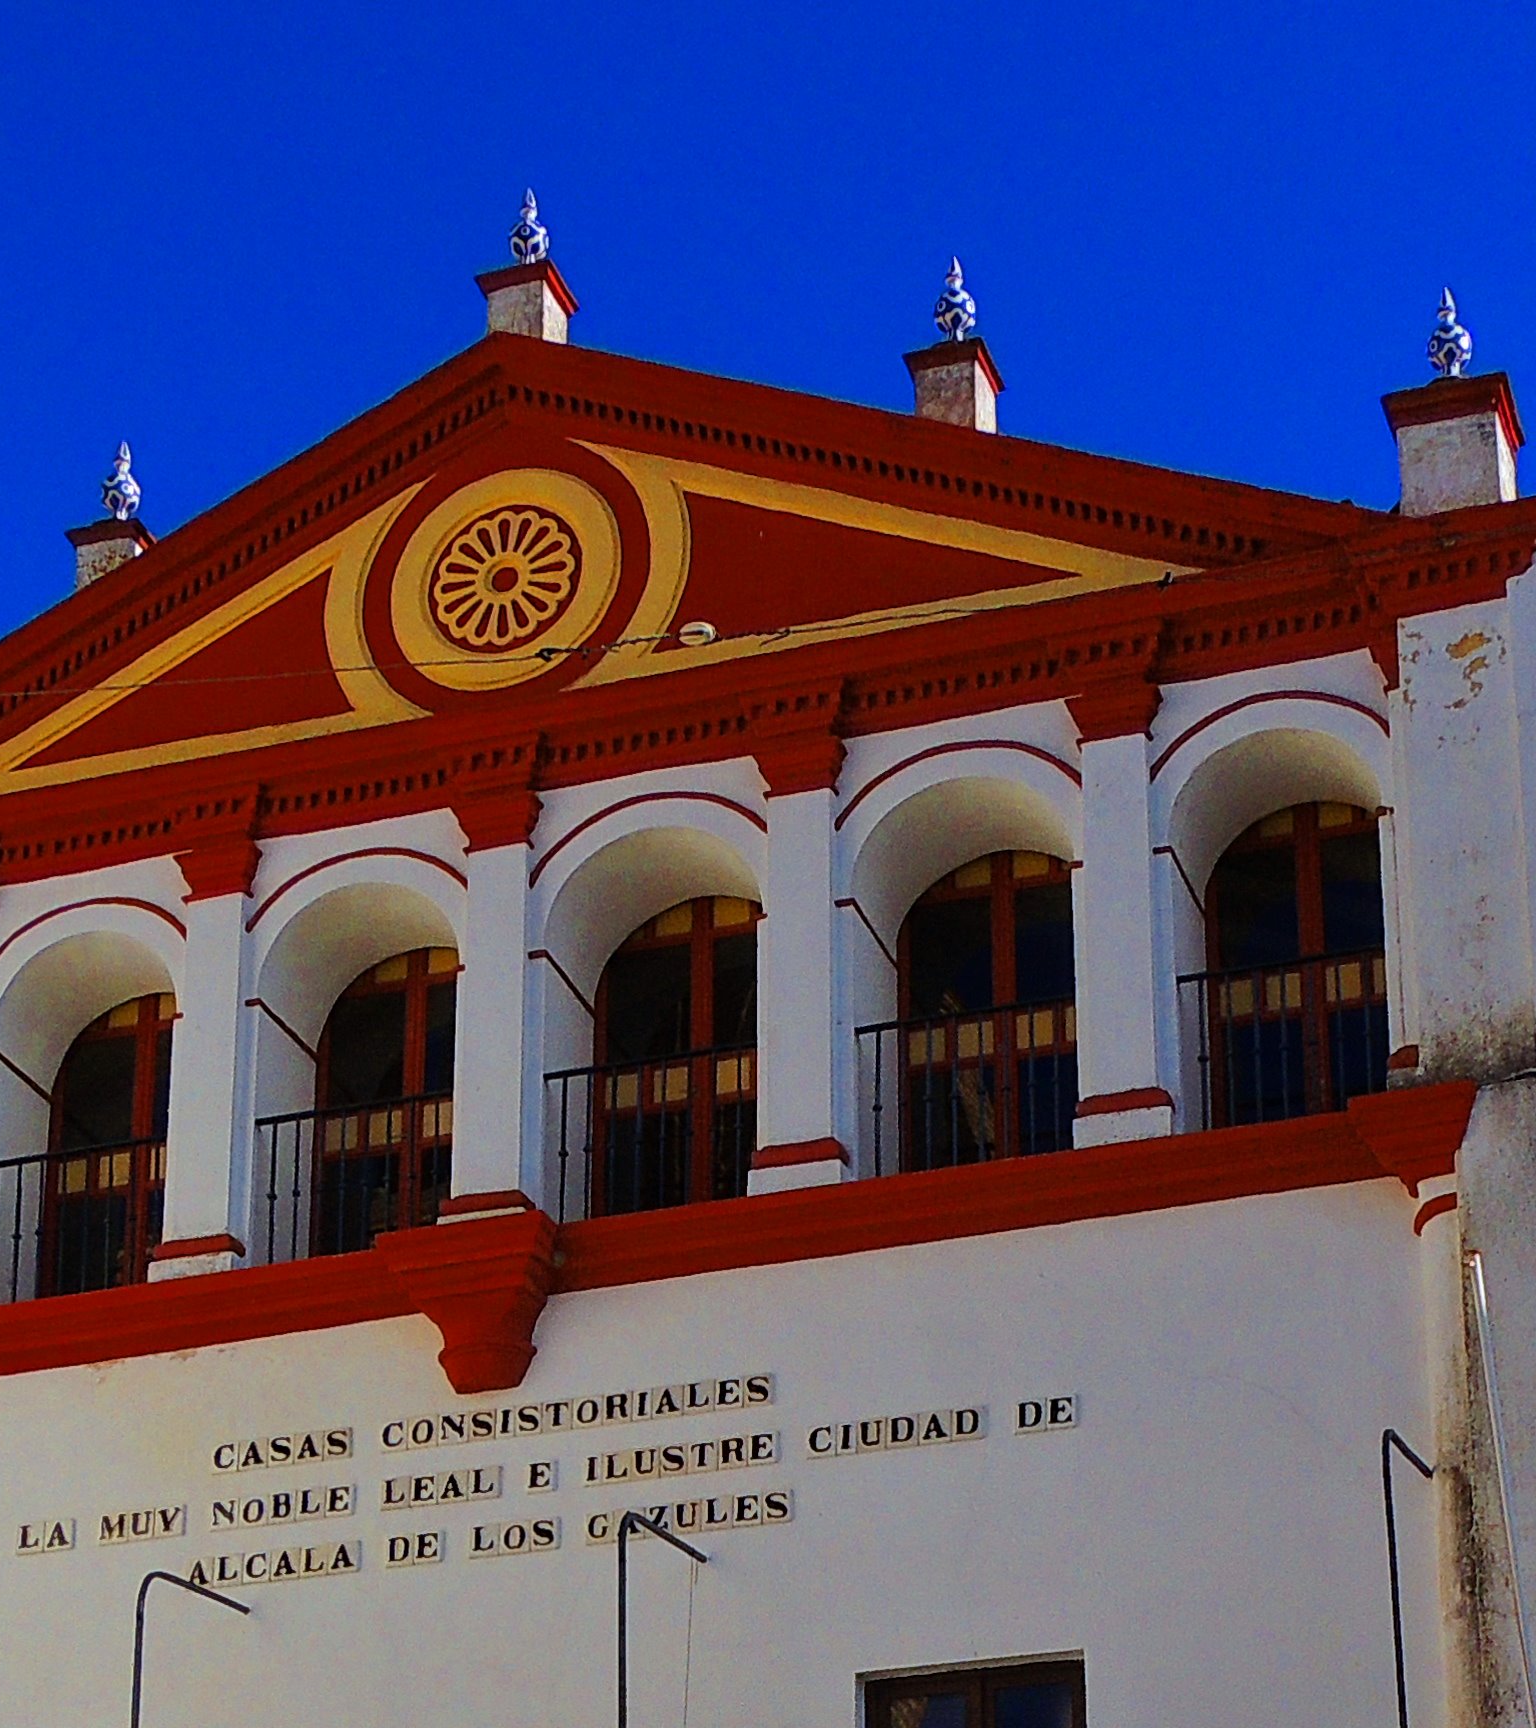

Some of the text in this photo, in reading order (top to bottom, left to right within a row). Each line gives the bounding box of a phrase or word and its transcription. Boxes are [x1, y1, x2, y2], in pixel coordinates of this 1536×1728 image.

[213, 1375, 770, 1470] CASAS CONSISTORIALES
[17, 1521, 70, 1550] LA
[98, 1505, 182, 1541] MUY
[211, 1485, 350, 1526] NOBLE
[382, 1465, 495, 1505] LEAL
[528, 1462, 552, 1488] E
[585, 1433, 773, 1482] ILUSTRE
[808, 1408, 979, 1453] CIUDAD
[1017, 1396, 1073, 1429] DE
[189, 1543, 355, 1586] ALCALA
[387, 1532, 438, 1562] DE
[472, 1519, 555, 1552] LOS
